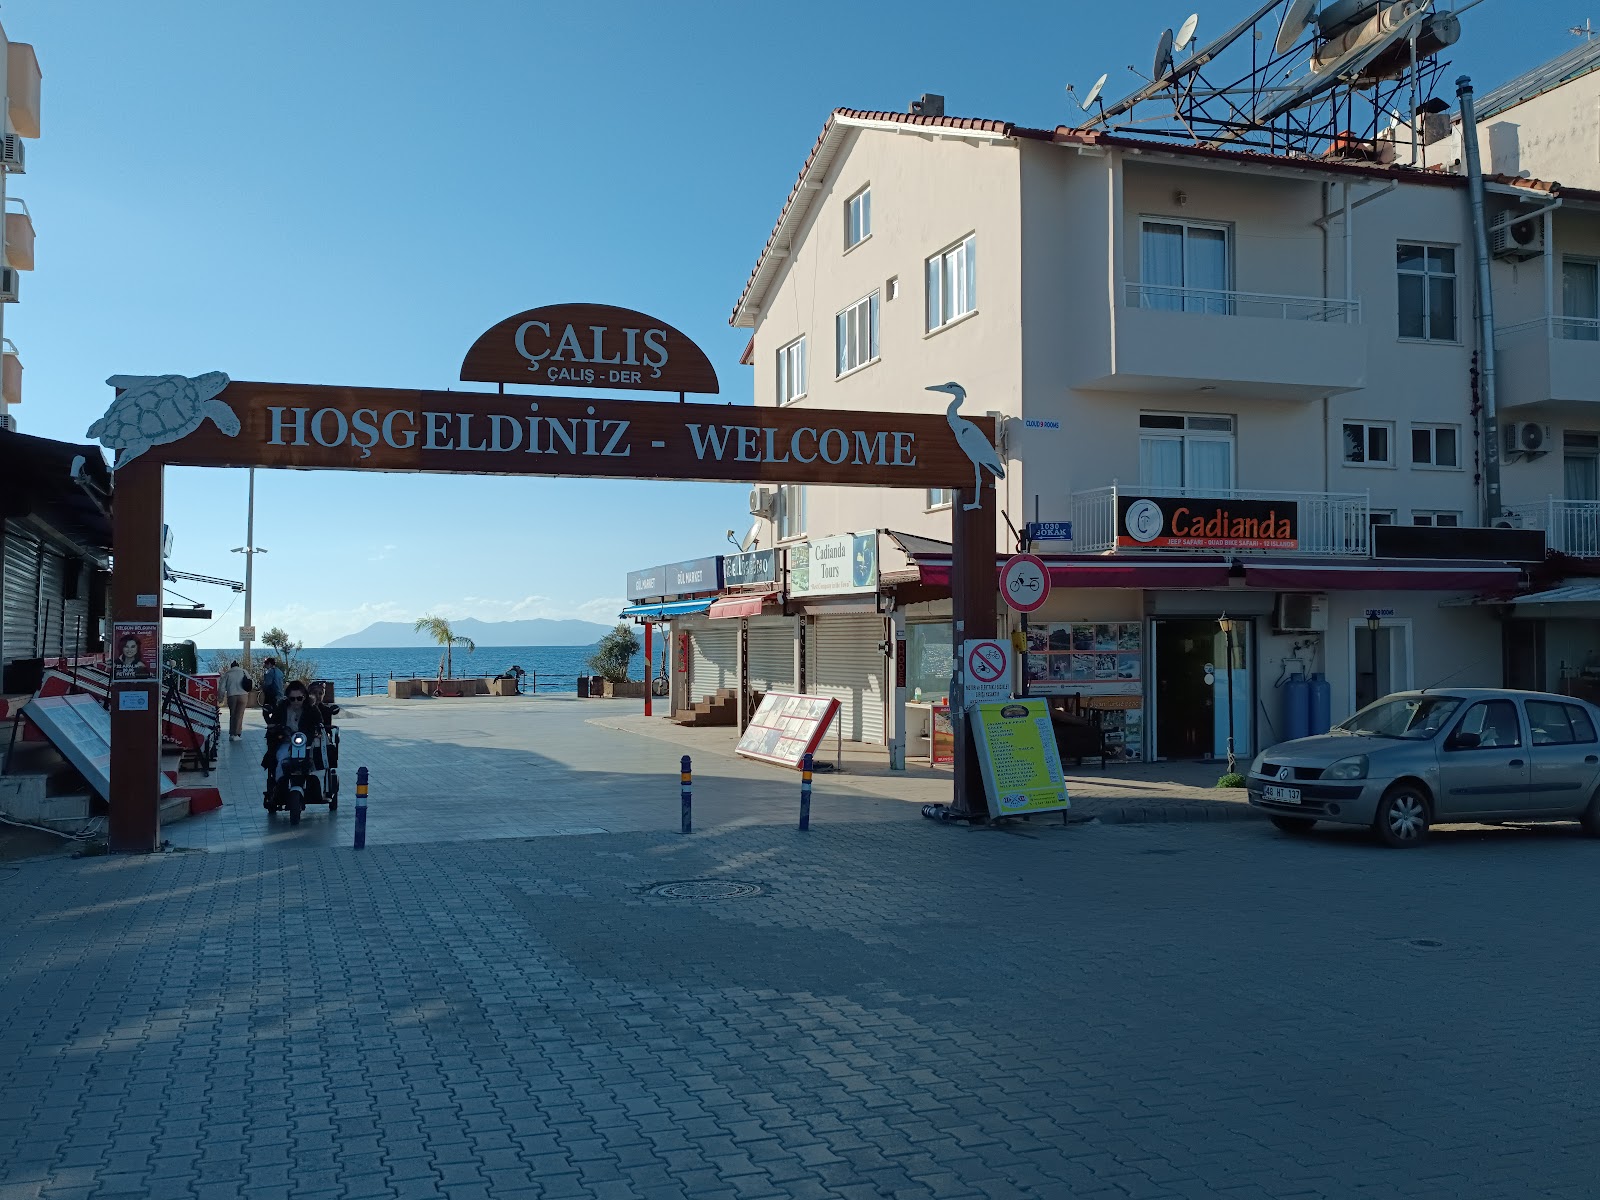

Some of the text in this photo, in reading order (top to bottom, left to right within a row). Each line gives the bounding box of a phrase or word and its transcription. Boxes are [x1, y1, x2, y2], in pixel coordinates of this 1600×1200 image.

[514, 320, 669, 378] ÇALIŞ
[547, 366, 595, 384] ÇALIŞ
[609, 369, 642, 384] DER
[266, 402, 631, 459] HOŞGELDİNİZ
[685, 423, 917, 467] WELCOME
[1172, 507, 1290, 539] Cadianda
[815, 542, 846, 561] Cadianda
[820, 563, 840, 579] Tours
[897, 641, 906, 687] RHODES
[1265, 786, 1300, 799] 48 HT 137
